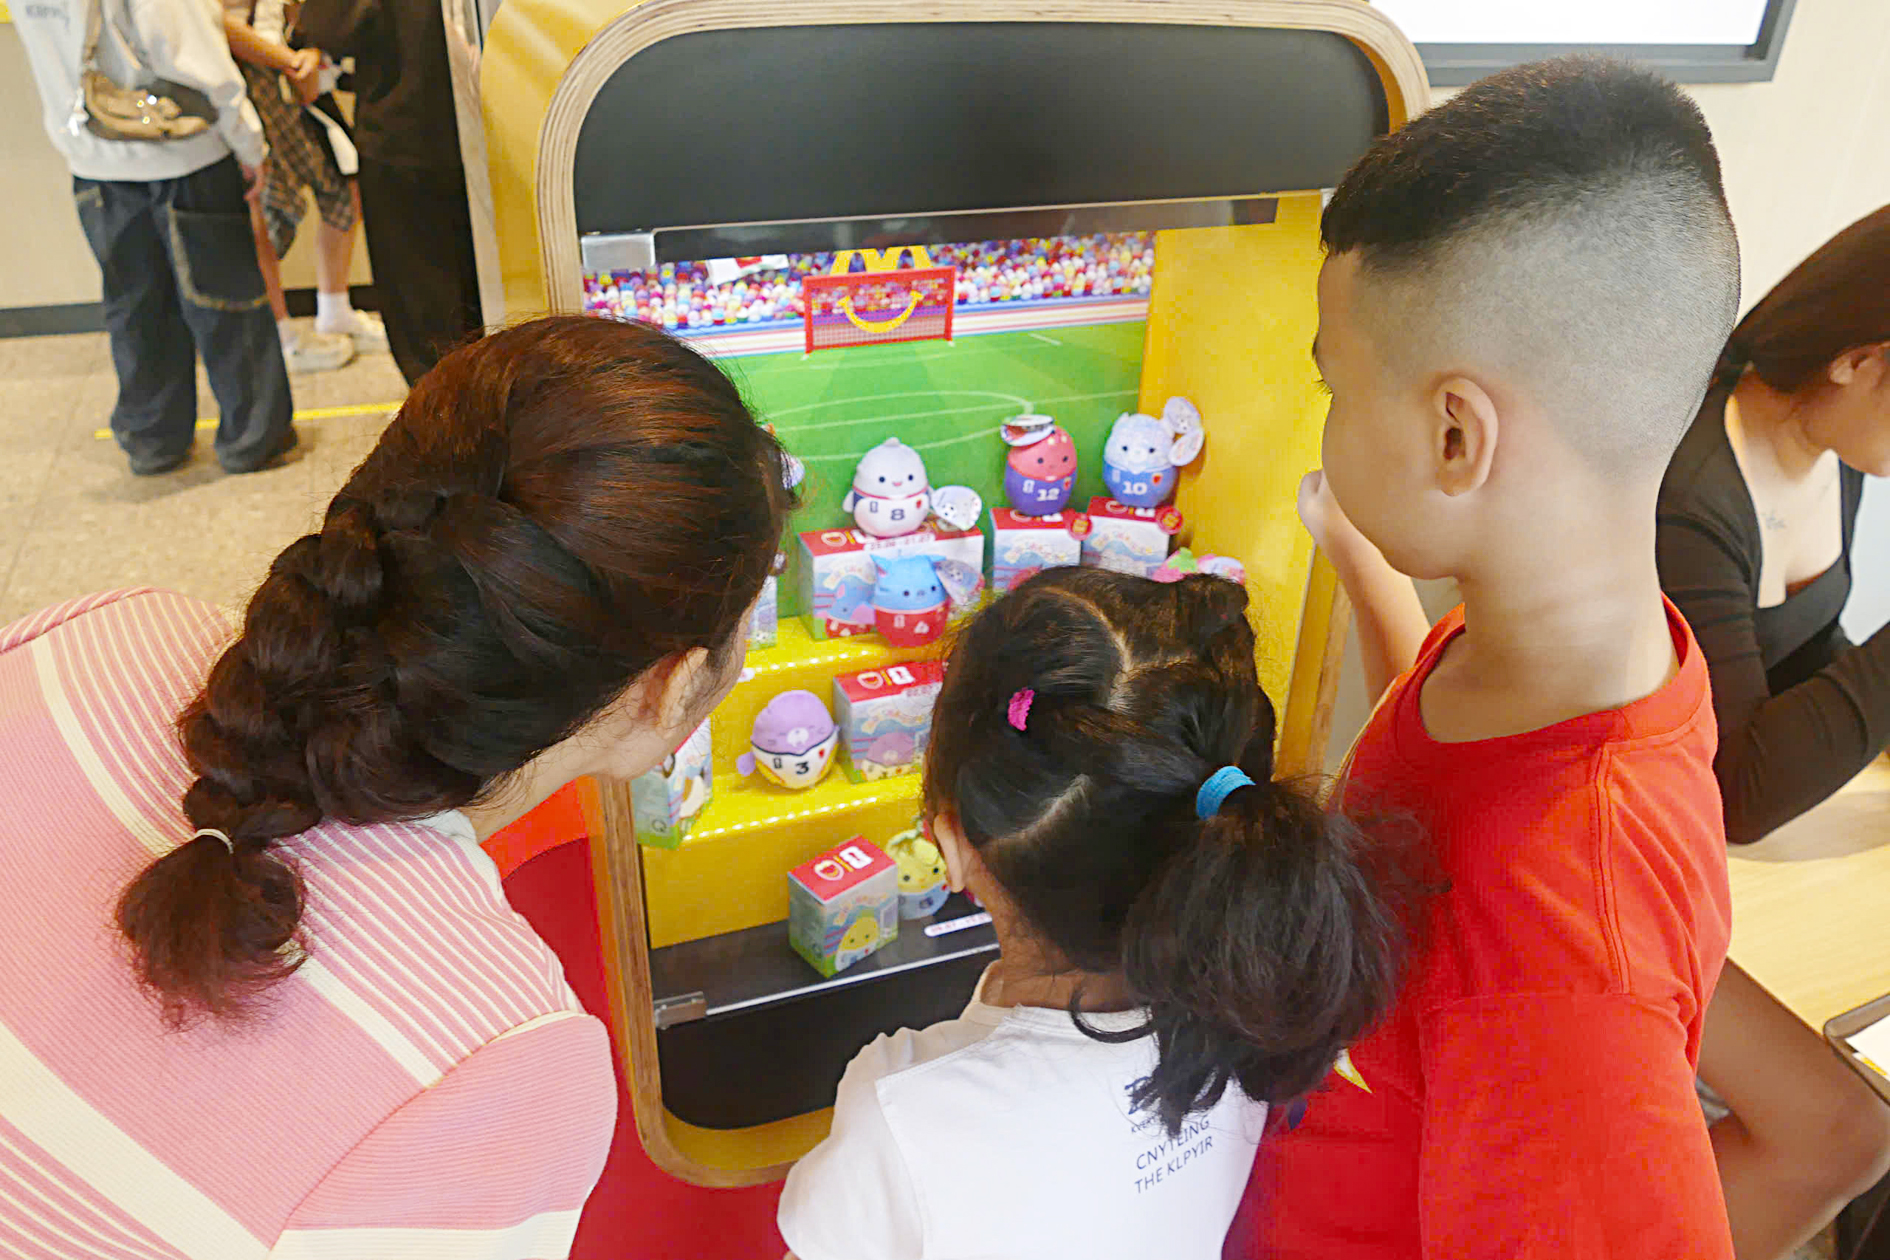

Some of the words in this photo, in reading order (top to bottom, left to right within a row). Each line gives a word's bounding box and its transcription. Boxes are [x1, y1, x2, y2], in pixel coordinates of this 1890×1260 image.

[1036, 488, 1060, 501] 12
[1122, 480, 1148, 495] 10
[890, 508, 905, 521] 8
[795, 761, 810, 775] 3
[1134, 1167, 1163, 1194] THE
[1166, 1136, 1213, 1176] KLPYIR
